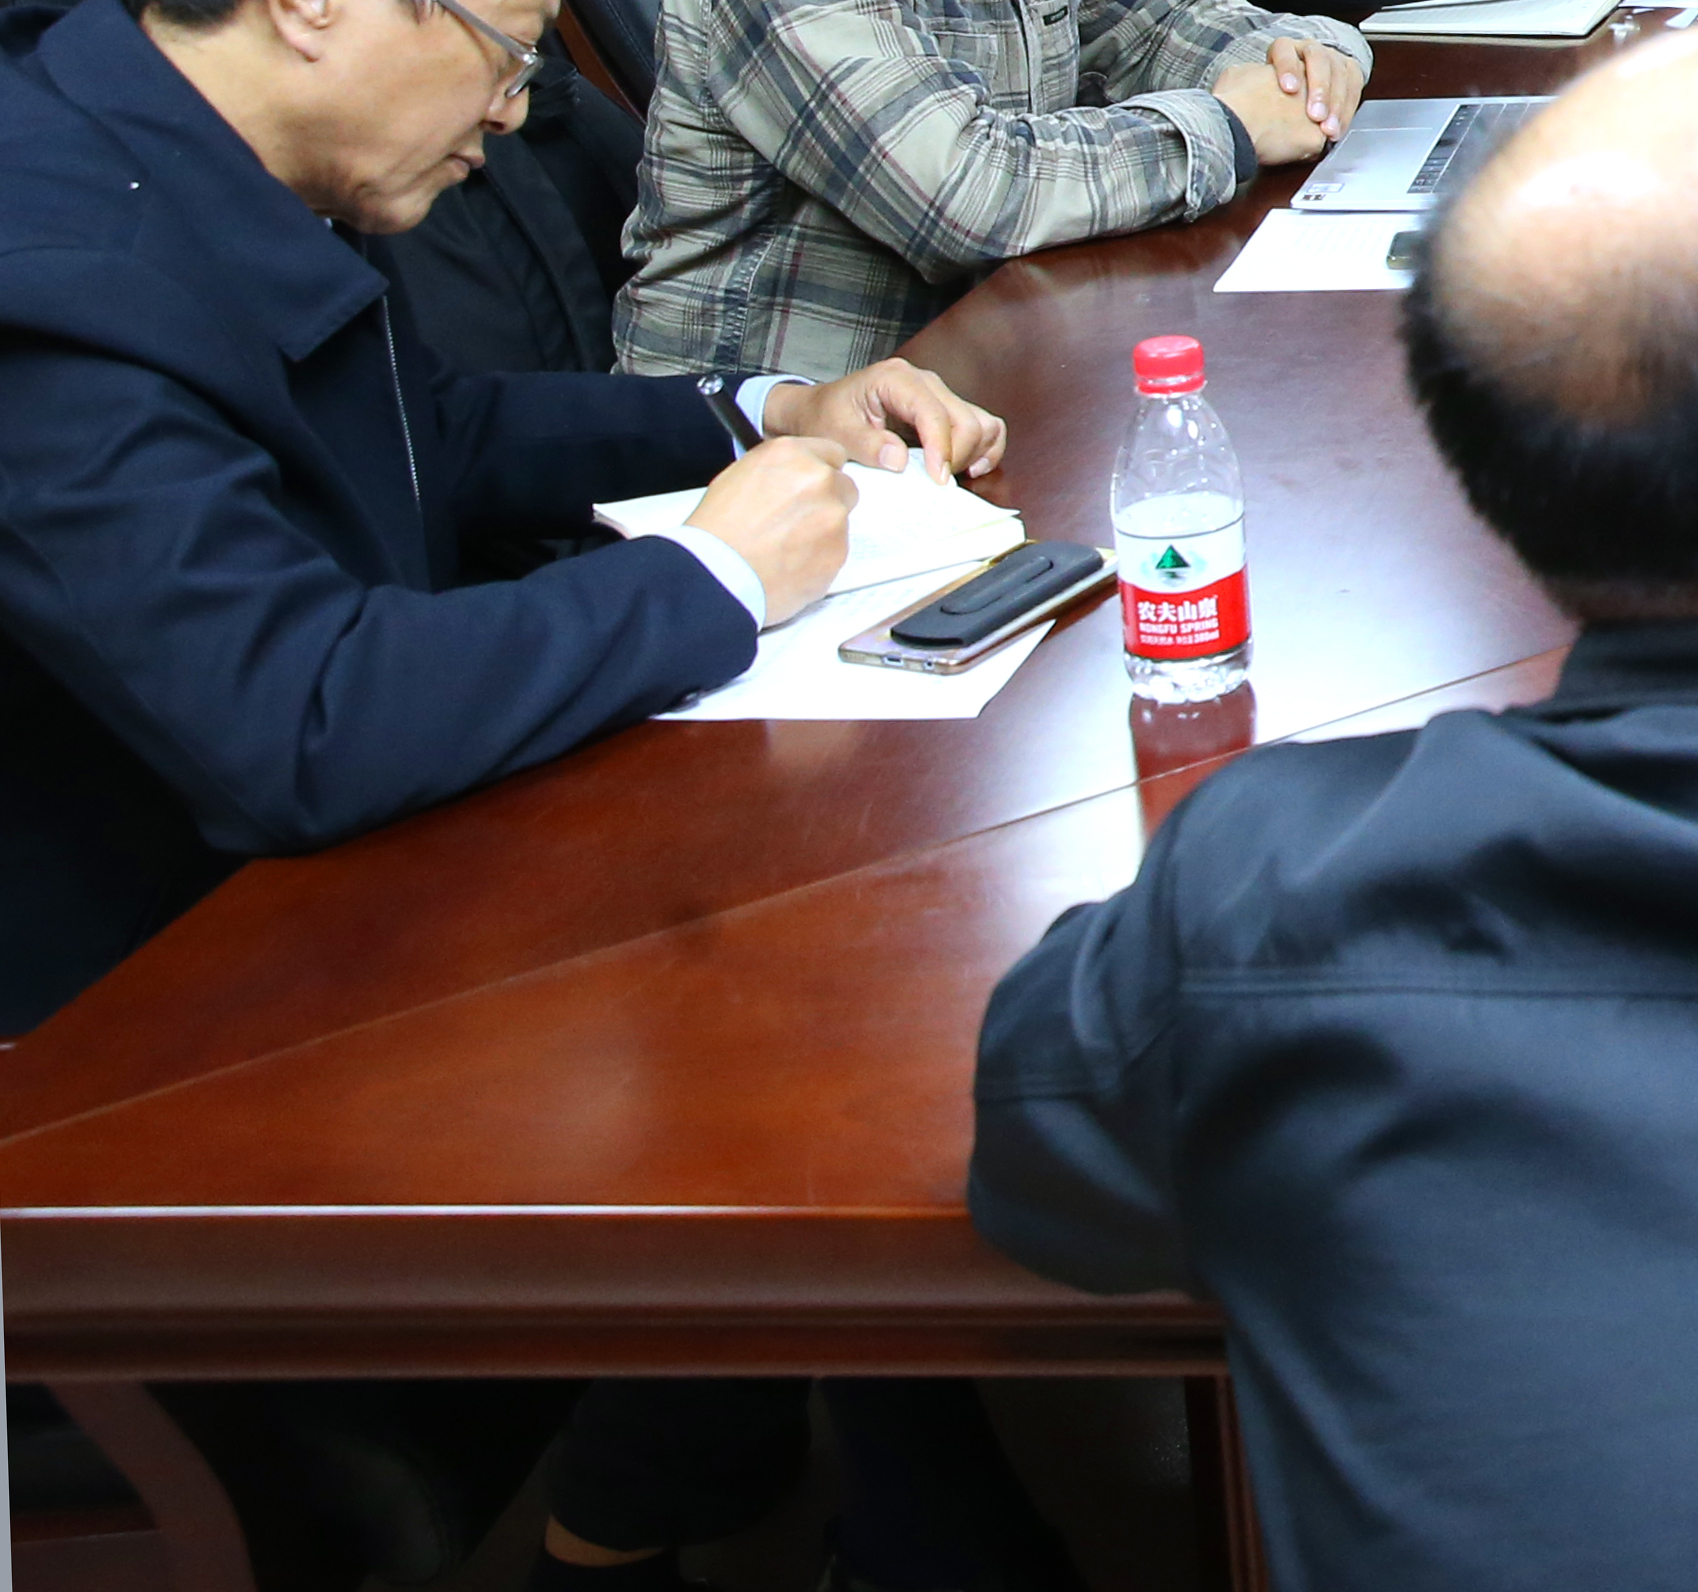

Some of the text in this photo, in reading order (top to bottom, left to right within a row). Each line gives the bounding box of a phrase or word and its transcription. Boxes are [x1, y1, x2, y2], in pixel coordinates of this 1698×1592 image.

[1137, 595, 1219, 622] 农夫山泉
[1180, 617, 1219, 634] SPRING
